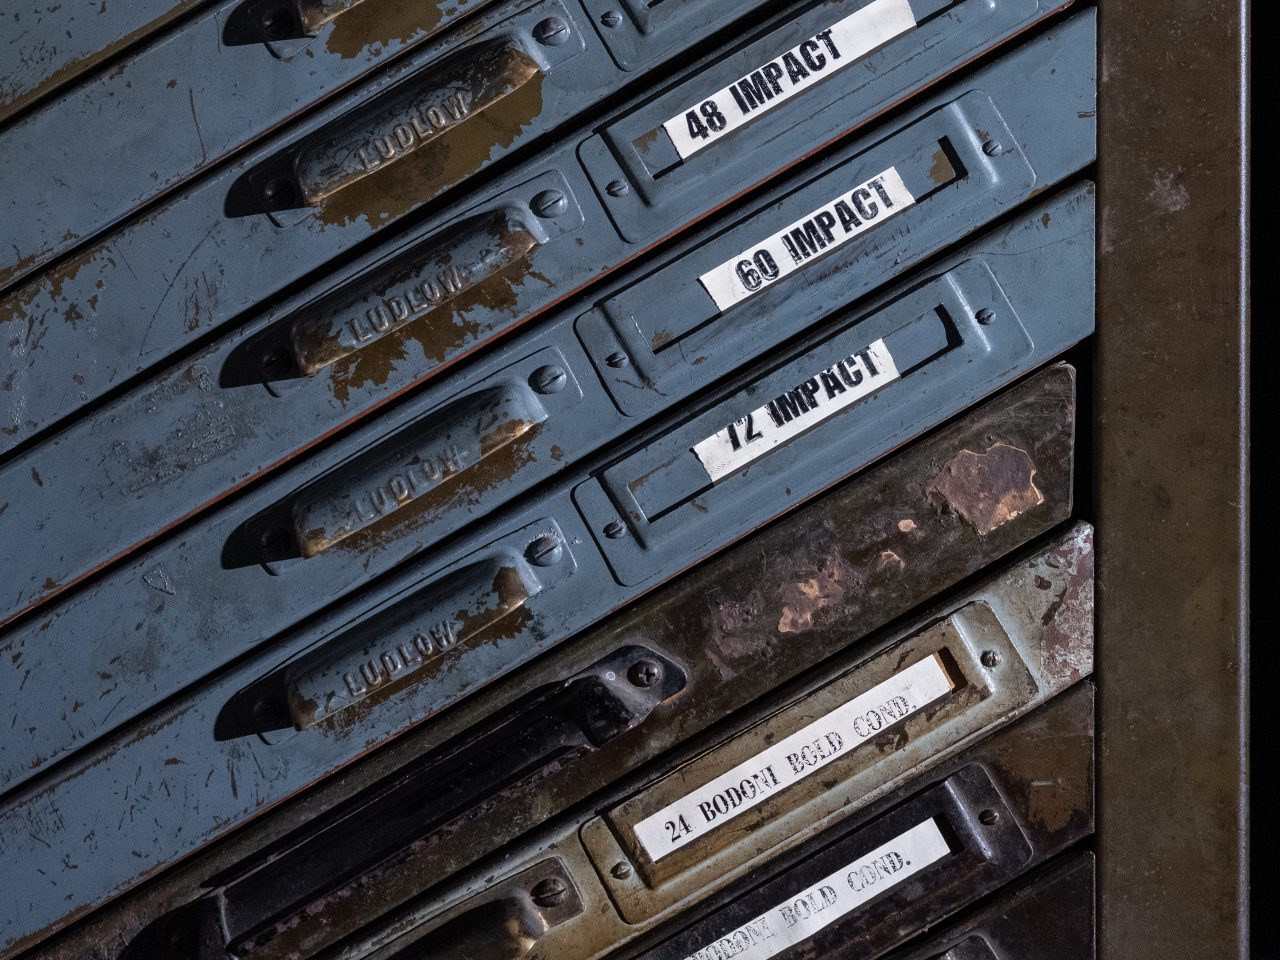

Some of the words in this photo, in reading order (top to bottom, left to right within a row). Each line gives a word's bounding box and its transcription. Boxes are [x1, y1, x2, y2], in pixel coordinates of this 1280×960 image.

[684, 99, 728, 141] 48
[729, 28, 842, 116] IMPACT
[358, 90, 469, 171] LUDLOW
[734, 248, 780, 292] 60
[781, 175, 895, 266] IMPACT
[349, 264, 463, 342] LUDLOW
[764, 345, 881, 428] IMPACT
[343, 619, 457, 696] LUDLOW
[664, 813, 694, 844] 24
[697, 764, 782, 825] BODONI
[785, 731, 844, 776] BOLD
[852, 694, 918, 739] COND.
[778, 885, 838, 929] BOLD
[846, 850, 913, 893] COND.
